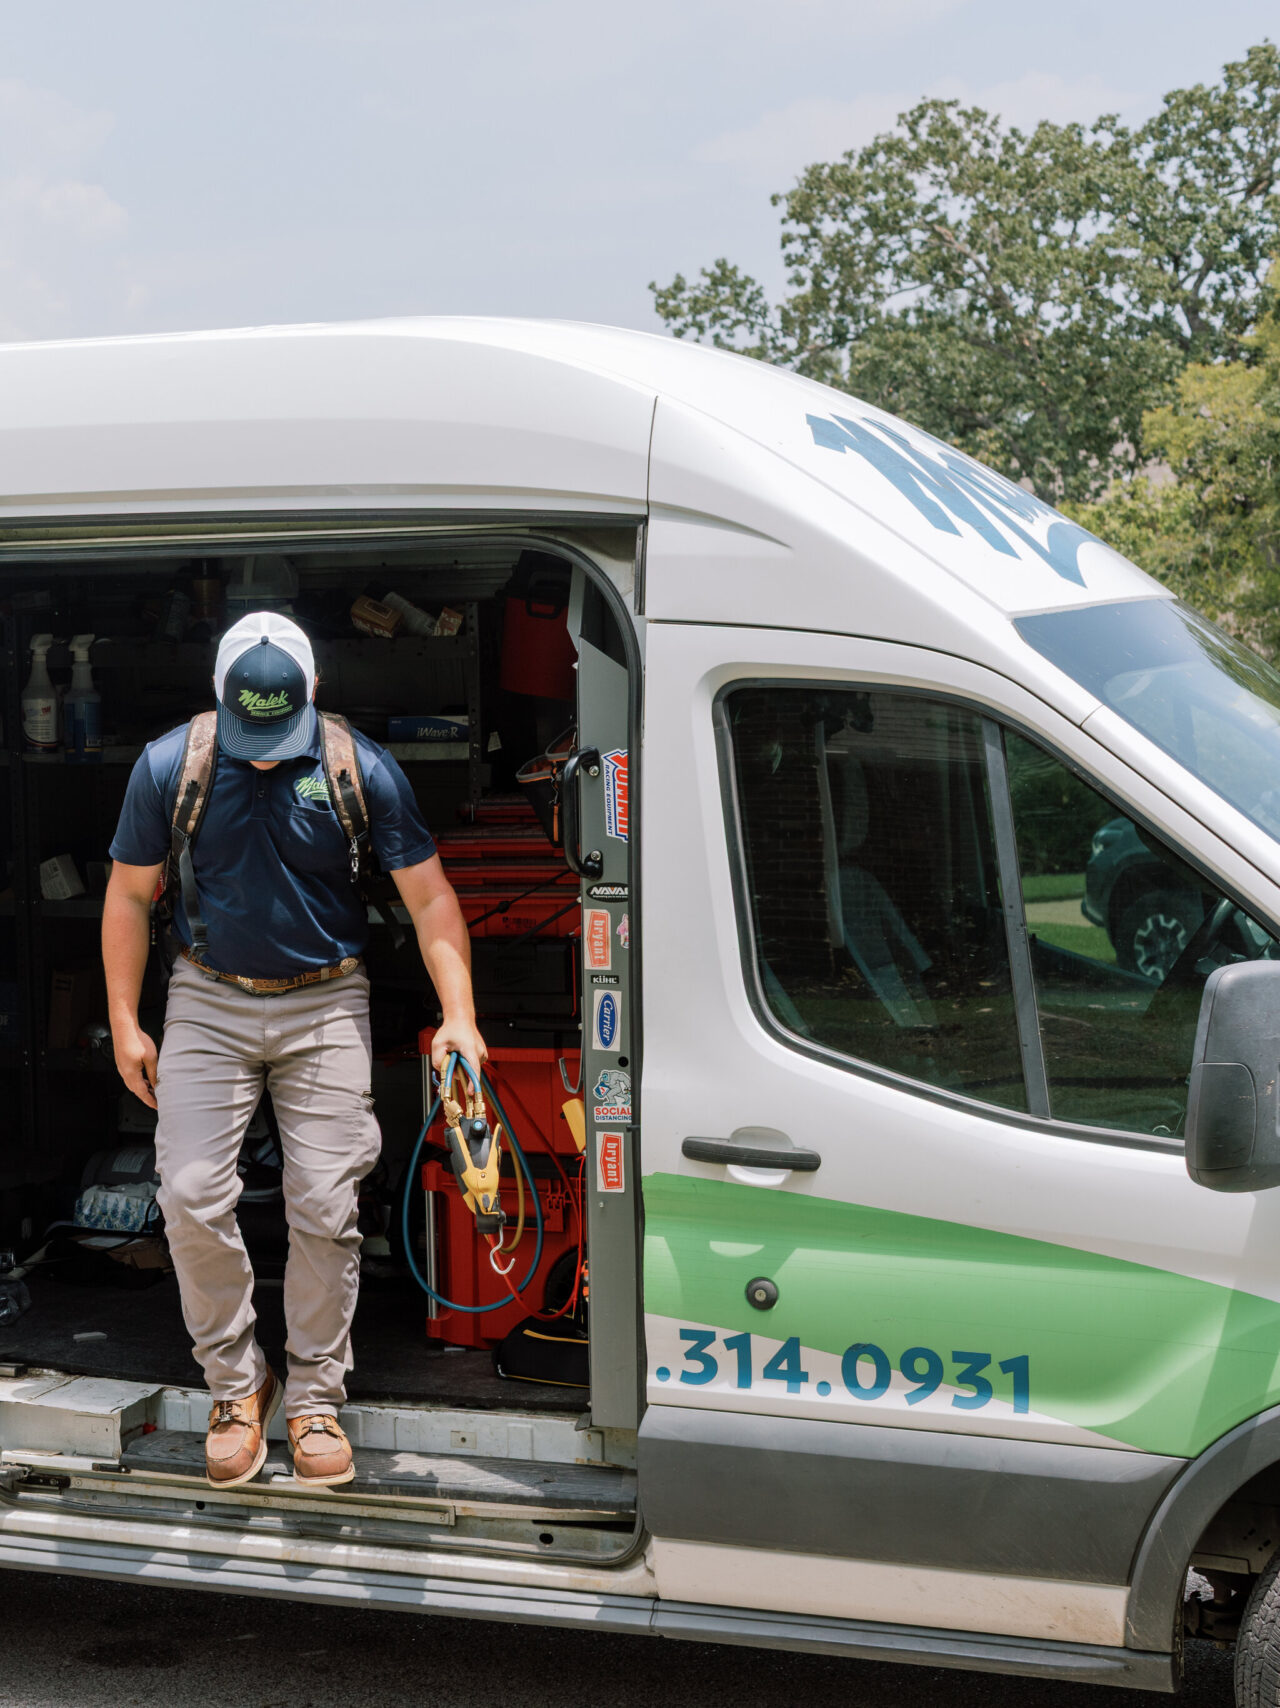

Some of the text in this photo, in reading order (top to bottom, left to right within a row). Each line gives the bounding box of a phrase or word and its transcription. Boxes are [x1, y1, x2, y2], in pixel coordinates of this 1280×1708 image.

[238, 689, 289, 711] Malek
[296, 776, 328, 798] Mal
[592, 919, 605, 960] bryant
[602, 999, 614, 1042] Carrier
[595, 1107, 632, 1115] SOCIAL
[605, 1142, 619, 1183] bryant
[655, 1327, 1031, 1414] .314.0931
